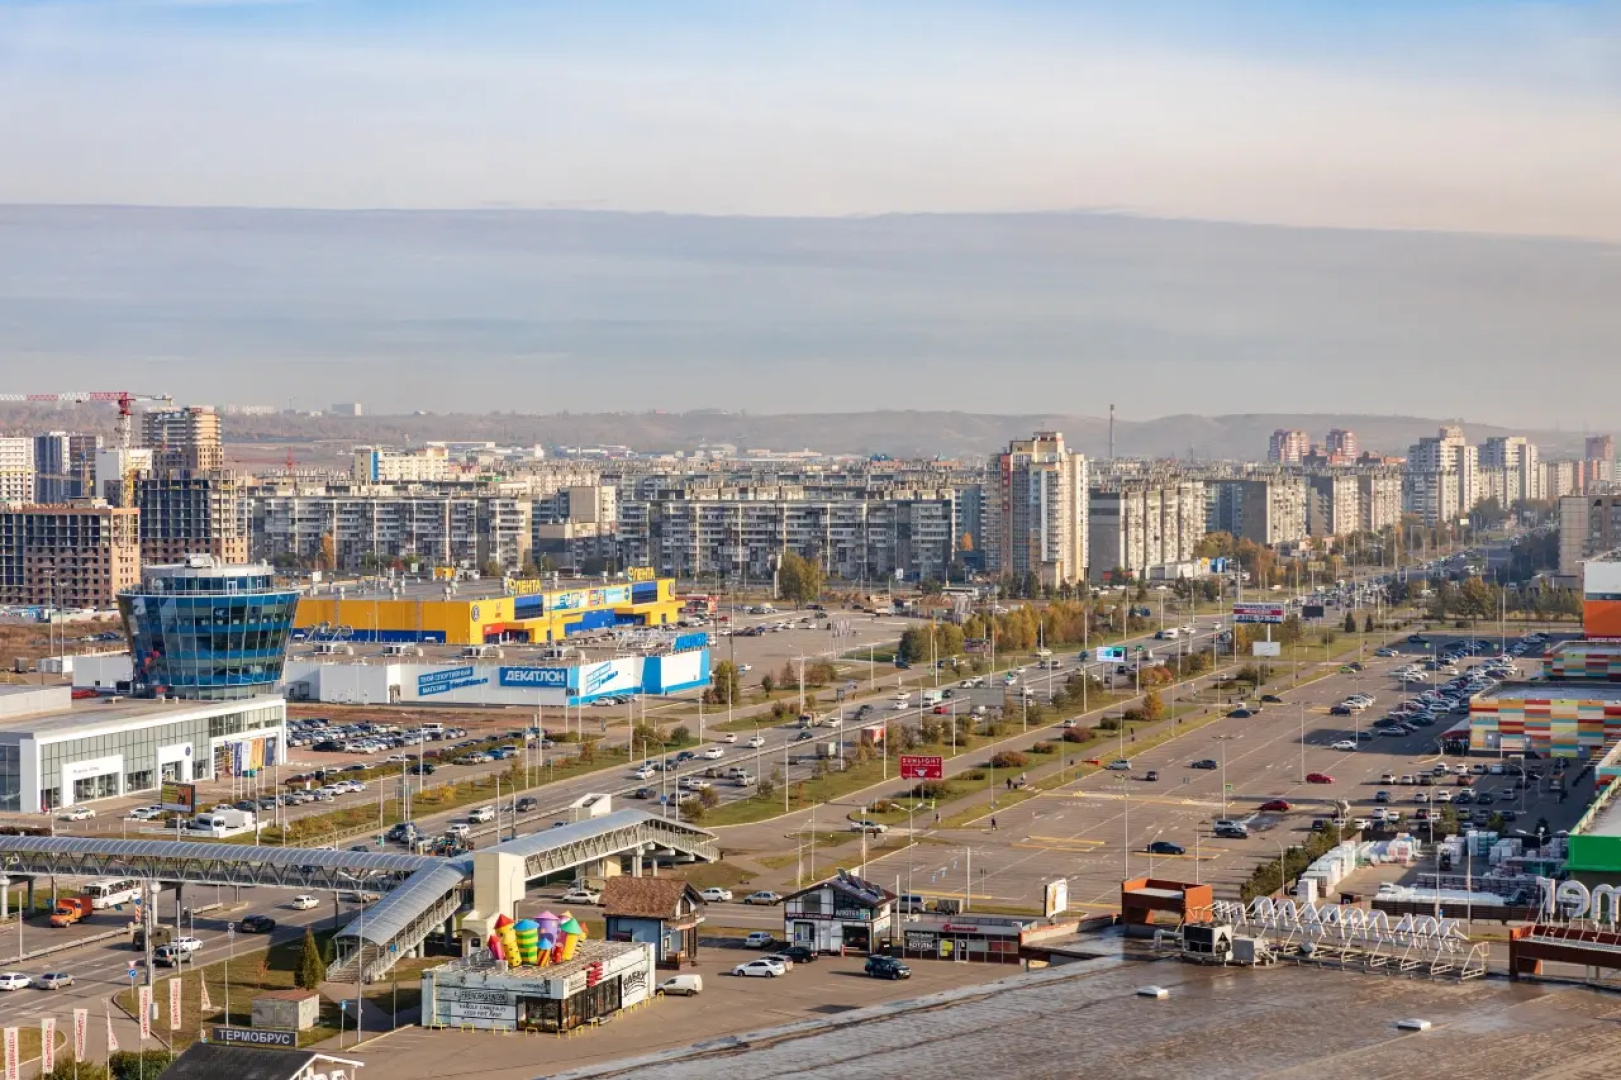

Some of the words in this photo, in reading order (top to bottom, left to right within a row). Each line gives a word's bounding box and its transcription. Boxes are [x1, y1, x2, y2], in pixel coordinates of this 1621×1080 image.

[634, 566, 656, 581] ЛЕНТА
[515, 579, 542, 595] ЛЕНТА
[505, 670, 565, 682] ДЕКАТЛОН
[909, 941, 933, 949] КОТЛЫ
[219, 1029, 290, 1044] ТЕРМОБРУС
